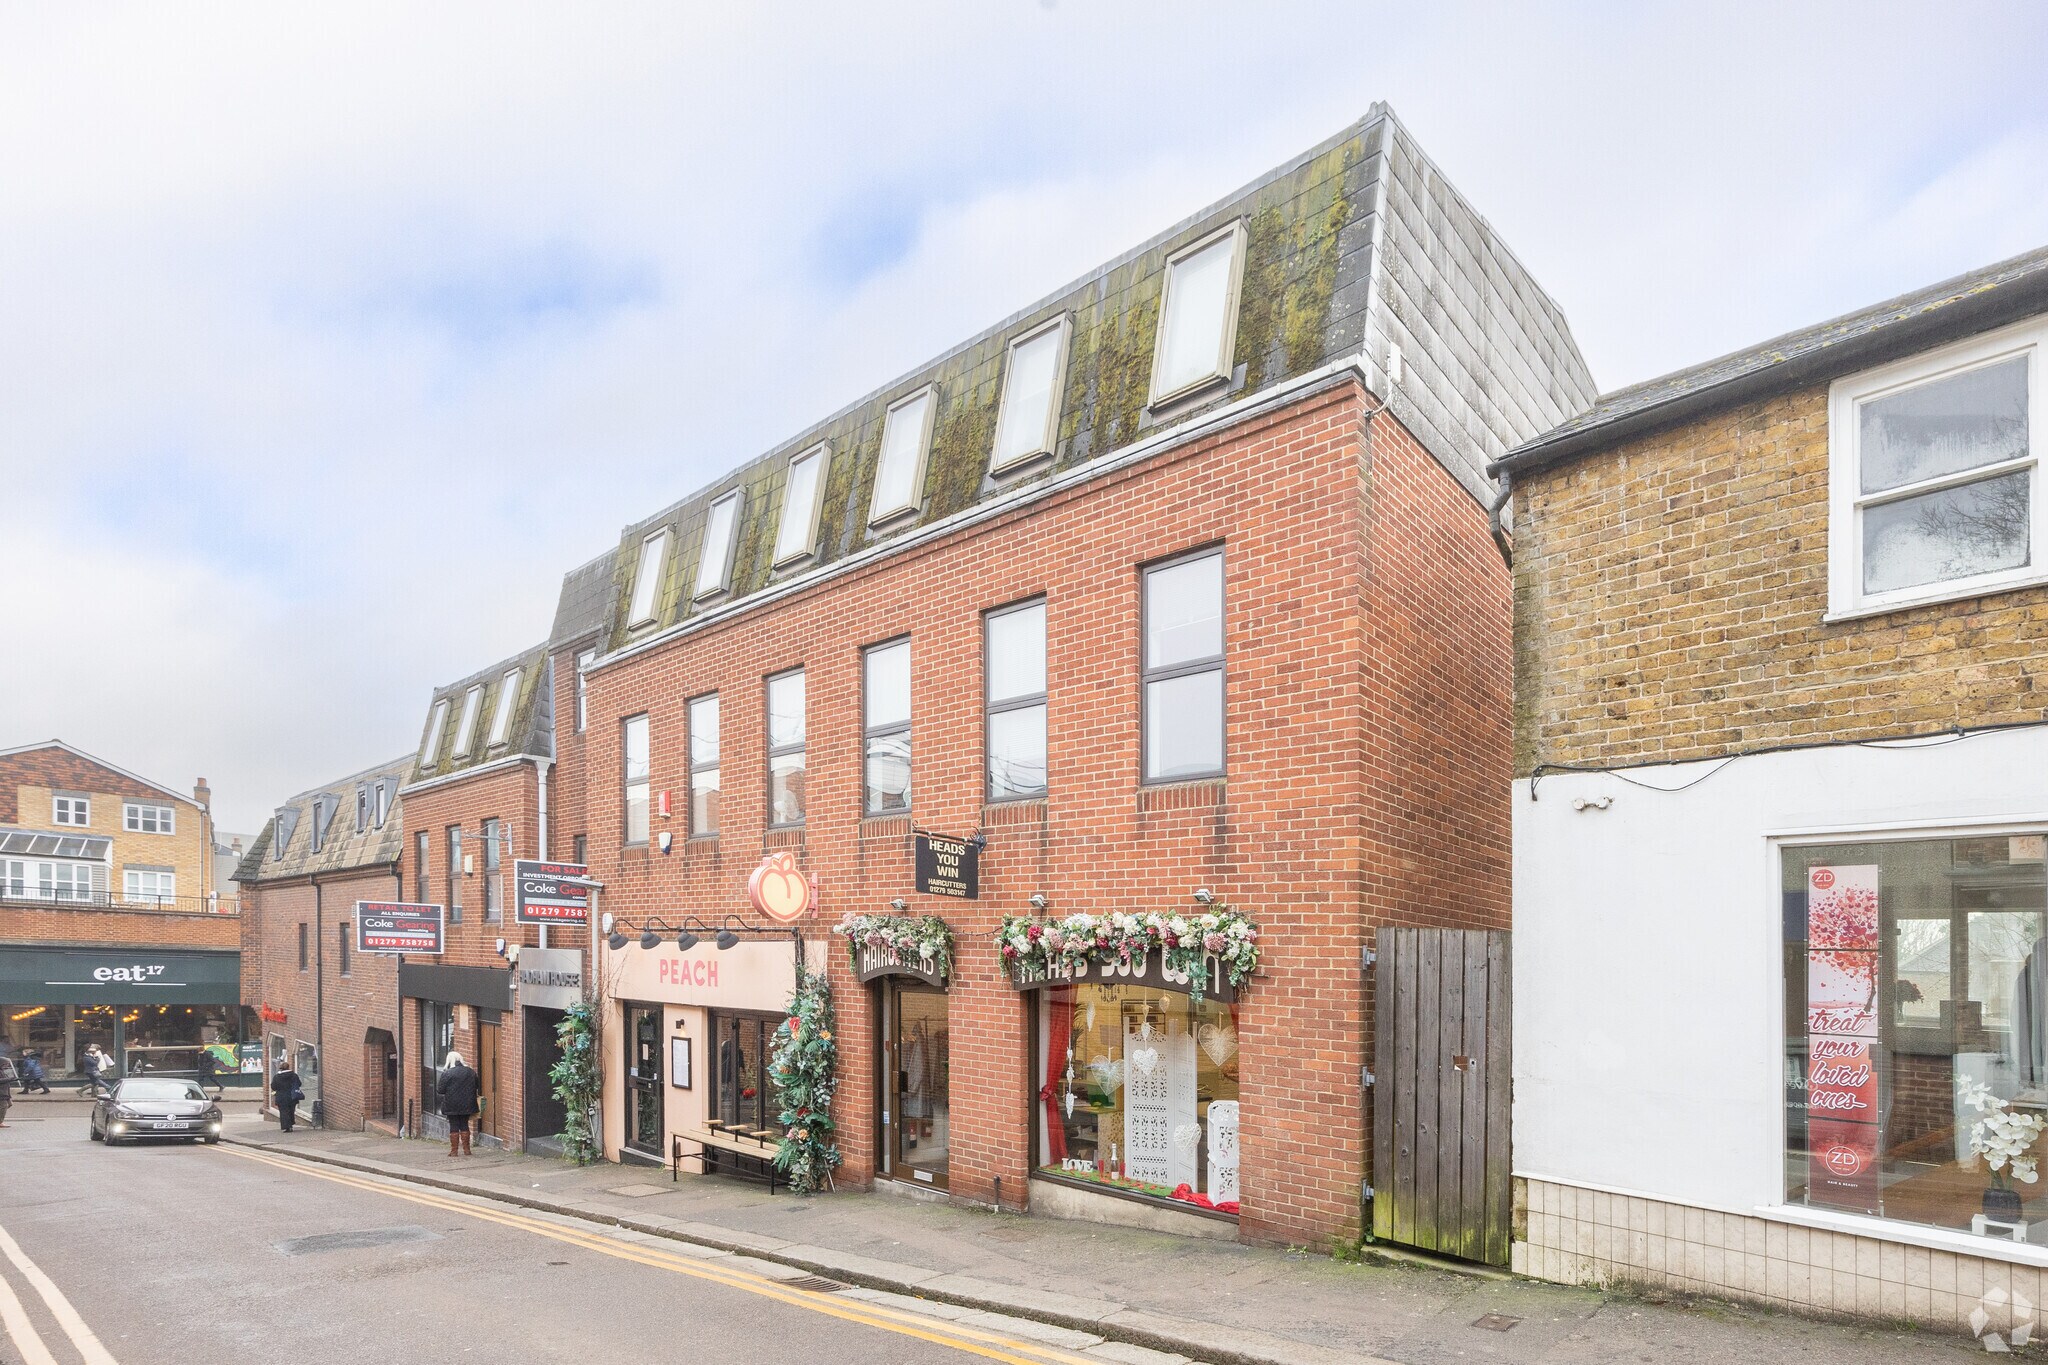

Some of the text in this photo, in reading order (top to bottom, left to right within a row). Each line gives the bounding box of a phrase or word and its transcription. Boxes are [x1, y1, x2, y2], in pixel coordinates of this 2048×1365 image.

[929, 840, 965, 855] HEADS
[937, 853, 959, 866] YOU
[541, 865, 560, 873] FOR
[937, 866, 959, 878] WIN
[928, 878, 966, 889] HAIRCUTTERS
[1815, 873, 1833, 882] ZD
[524, 882, 586, 895] Coke Gear
[527, 907, 559, 915] 01279
[365, 918, 435, 931] Coke Gearing
[660, 959, 718, 987] PEACH
[1812, 1009, 1874, 1032] treat
[1811, 1039, 1865, 1060] your
[1811, 1061, 1869, 1087] loved
[1811, 1090, 1867, 1109] ones
[1831, 1151, 1855, 1165] ZD
[1061, 1158, 1093, 1172] LOVE
